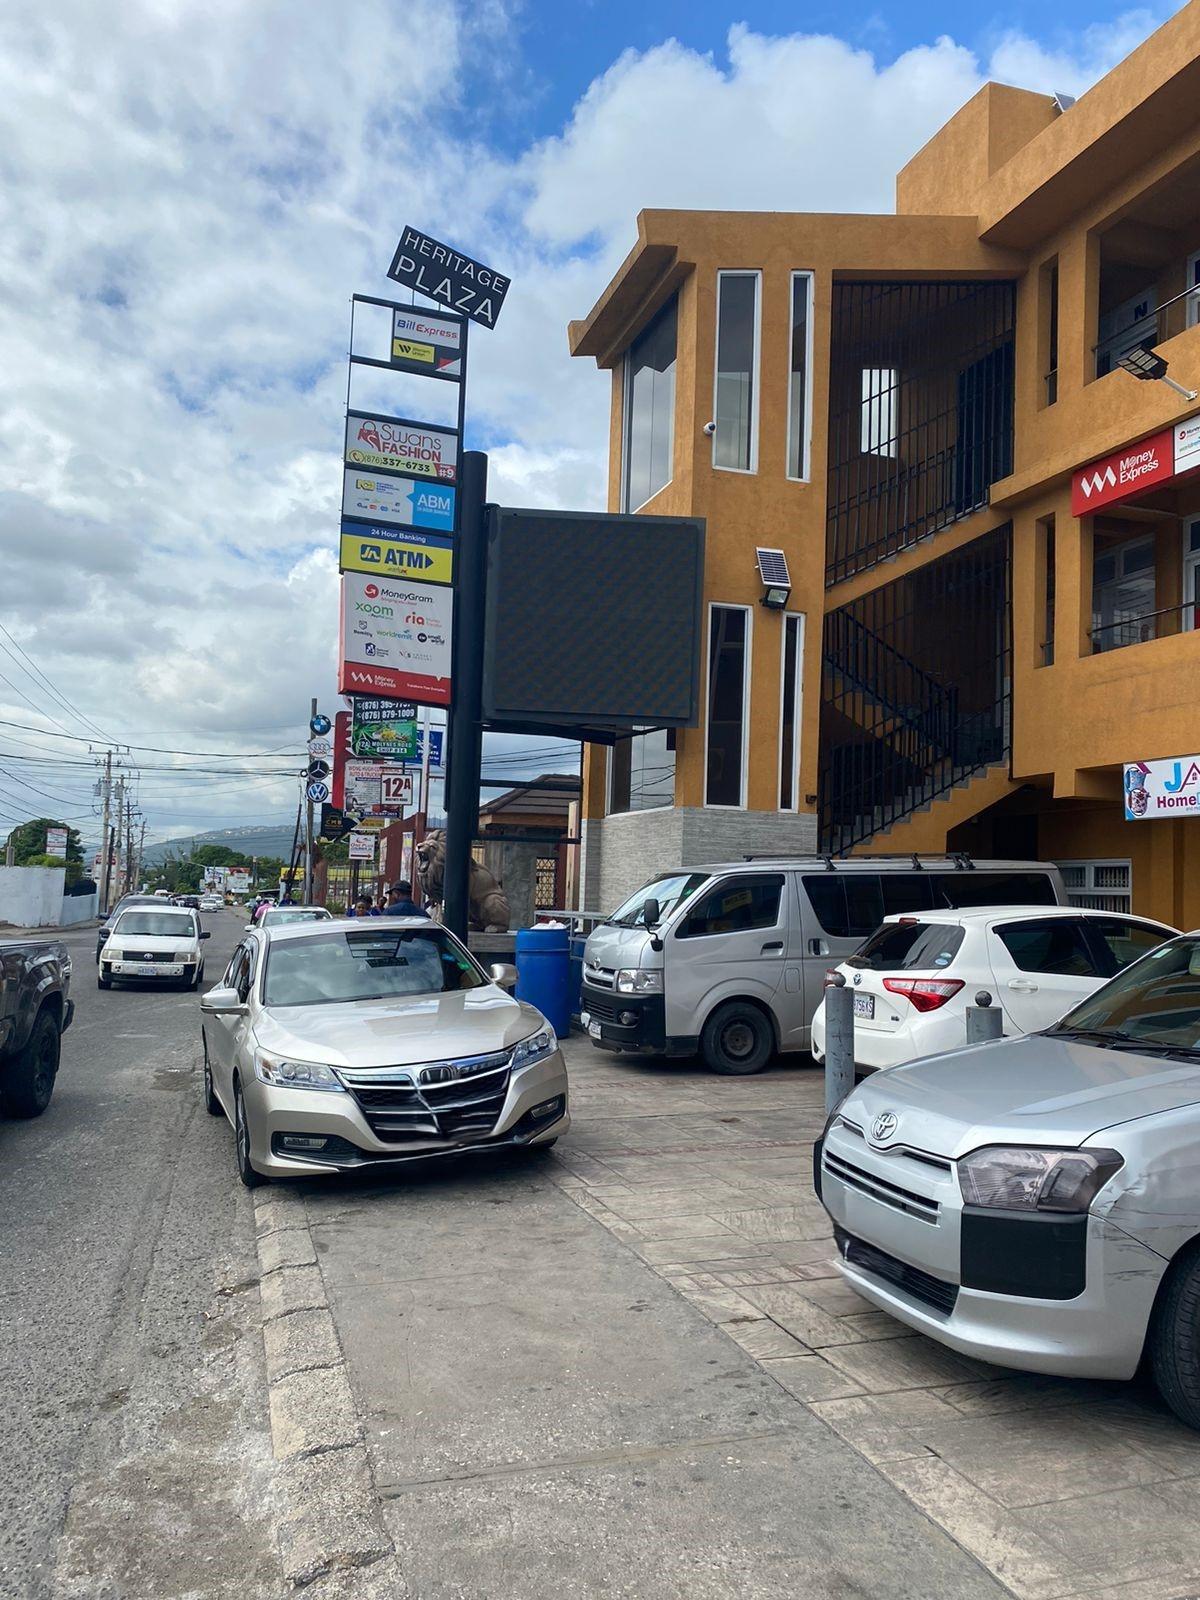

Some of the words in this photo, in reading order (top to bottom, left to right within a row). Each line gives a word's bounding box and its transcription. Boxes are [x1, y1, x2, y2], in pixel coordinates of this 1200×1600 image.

[405, 232, 505, 295] HERITAGE
[394, 255, 493, 323] PLAZA
[380, 424, 442, 450] Swans
[382, 441, 442, 462] FASHION
[1119, 448, 1155, 471] Money
[1119, 460, 1159, 484] Express
[417, 494, 451, 511] ABM
[371, 528, 380, 536] 24
[381, 530, 398, 538] Hour
[399, 532, 427, 544] Banking
[384, 548, 423, 569] ATM
[381, 588, 433, 603] MoneyGram
[355, 602, 393, 617] xoom
[405, 611, 424, 626] ria
